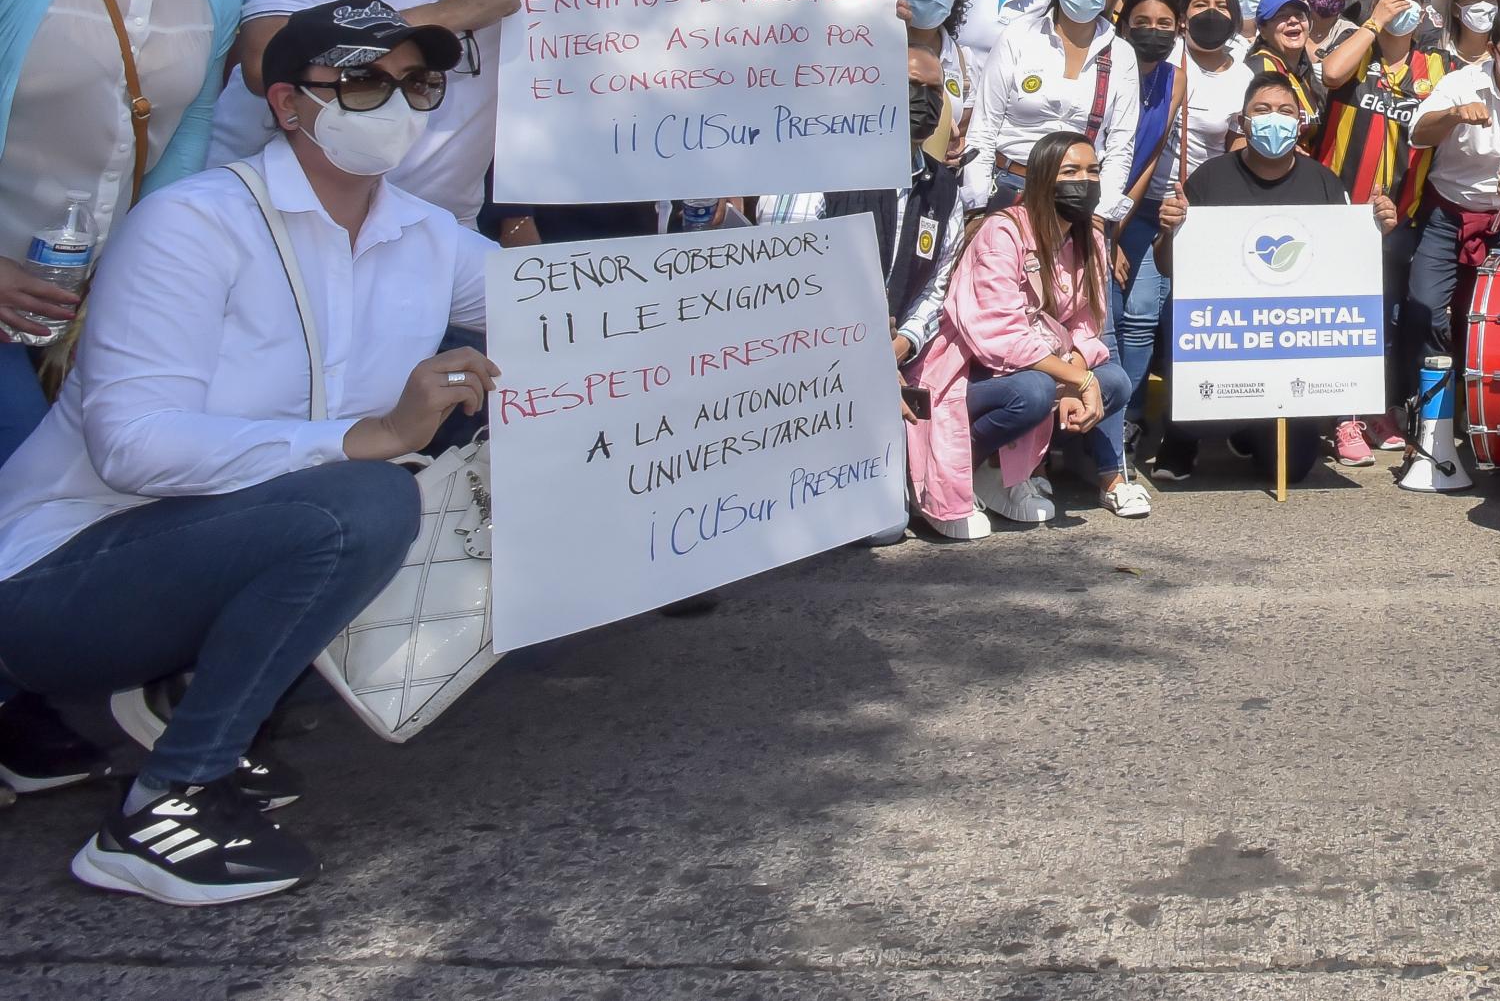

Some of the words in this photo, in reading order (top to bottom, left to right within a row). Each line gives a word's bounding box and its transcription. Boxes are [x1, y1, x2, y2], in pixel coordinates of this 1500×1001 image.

[529, 22, 639, 61] ÍNTEGRO
[667, 25, 809, 50] ASIGNADO
[827, 25, 873, 47] POR
[532, 77, 574, 99] EL
[590, 68, 734, 94] CONGRESO
[748, 66, 787, 88] DEL
[795, 65, 887, 87] ESTADO.
[513, 252, 648, 302] SEÑOR
[654, 232, 829, 281] GOBERNADOR:
[604, 302, 665, 339] LE
[678, 274, 822, 323] EXIGIMOS
[1190, 306, 1212, 327] SÍ
[1217, 310, 1247, 326] AL
[1253, 307, 1365, 325] HOSPITAL
[1179, 333, 1238, 350] CIVIL
[1243, 332, 1273, 349] DE
[1279, 329, 1376, 348] ORIENTE
[499, 365, 670, 424] RESPETO
[690, 323, 866, 377] IRRESTRICTO
[587, 431, 613, 463] A
[635, 415, 674, 447] LA
[695, 360, 844, 431] AUTONOMÍA
